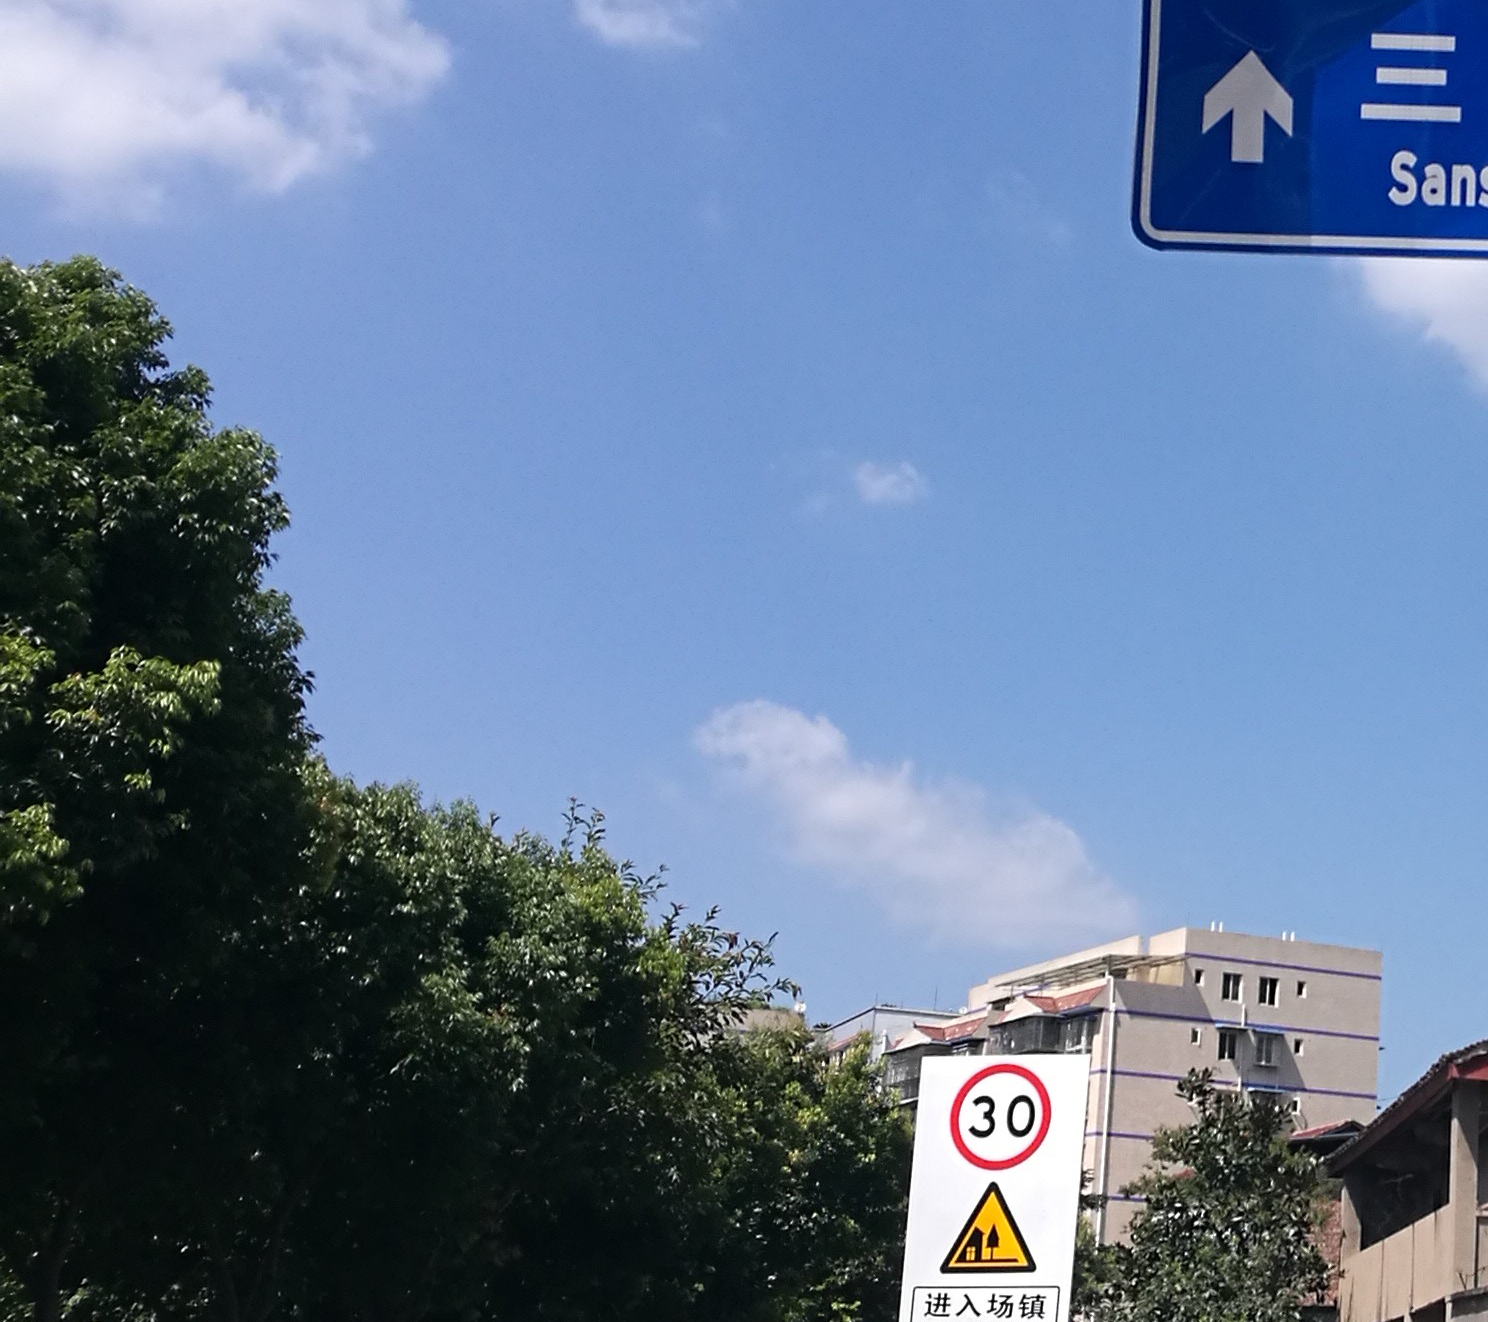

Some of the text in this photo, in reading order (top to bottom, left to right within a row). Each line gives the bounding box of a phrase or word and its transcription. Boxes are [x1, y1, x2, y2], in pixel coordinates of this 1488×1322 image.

[968, 1094, 1036, 1139] 30
[924, 1293, 1047, 1319] 进入场镇
